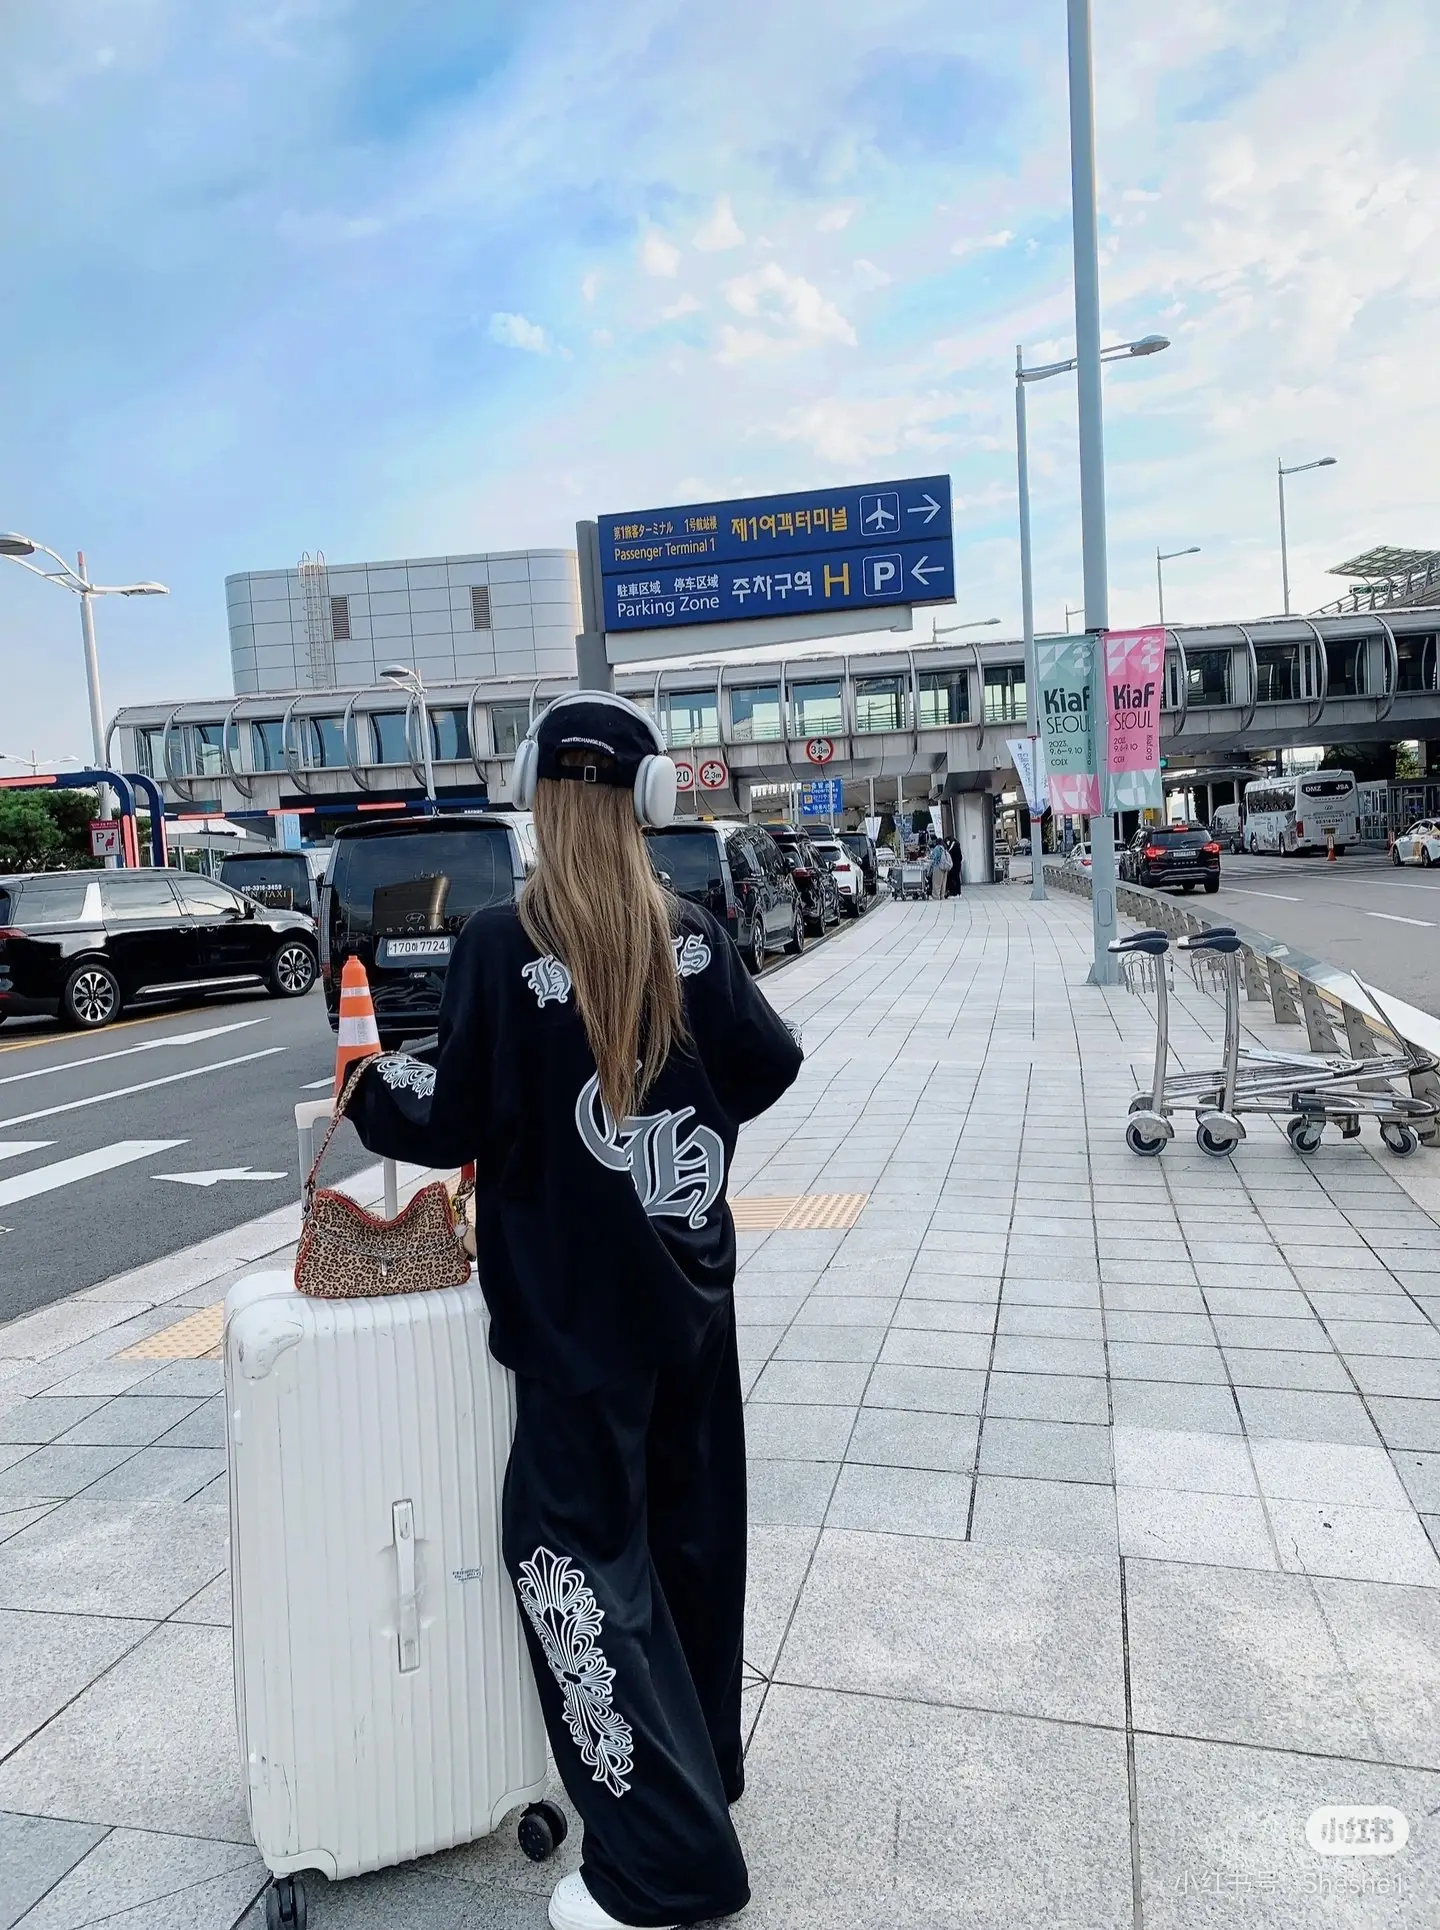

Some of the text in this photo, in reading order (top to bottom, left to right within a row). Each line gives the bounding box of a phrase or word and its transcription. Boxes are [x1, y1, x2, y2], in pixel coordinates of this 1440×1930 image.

[731, 506, 848, 542] 제1여객터미널
[614, 537, 716, 561] Passenger Terminal 1
[674, 573, 719, 593] 停车区域
[823, 562, 850, 597] H
[873, 562, 896, 590] P
[617, 580, 661, 597] 駐車区域
[731, 571, 813, 603] 주차구역
[617, 596, 720, 617] Parking Zone
[1044, 685, 1090, 714] Kiaf
[1113, 682, 1156, 710] Kiaf
[1046, 715, 1091, 734] SEOUL
[1114, 710, 1153, 731] SEOUL
[676, 770, 690, 782] 20
[704, 769, 722, 780] 2.3m
[1305, 783, 1350, 793] DMZ JSA
